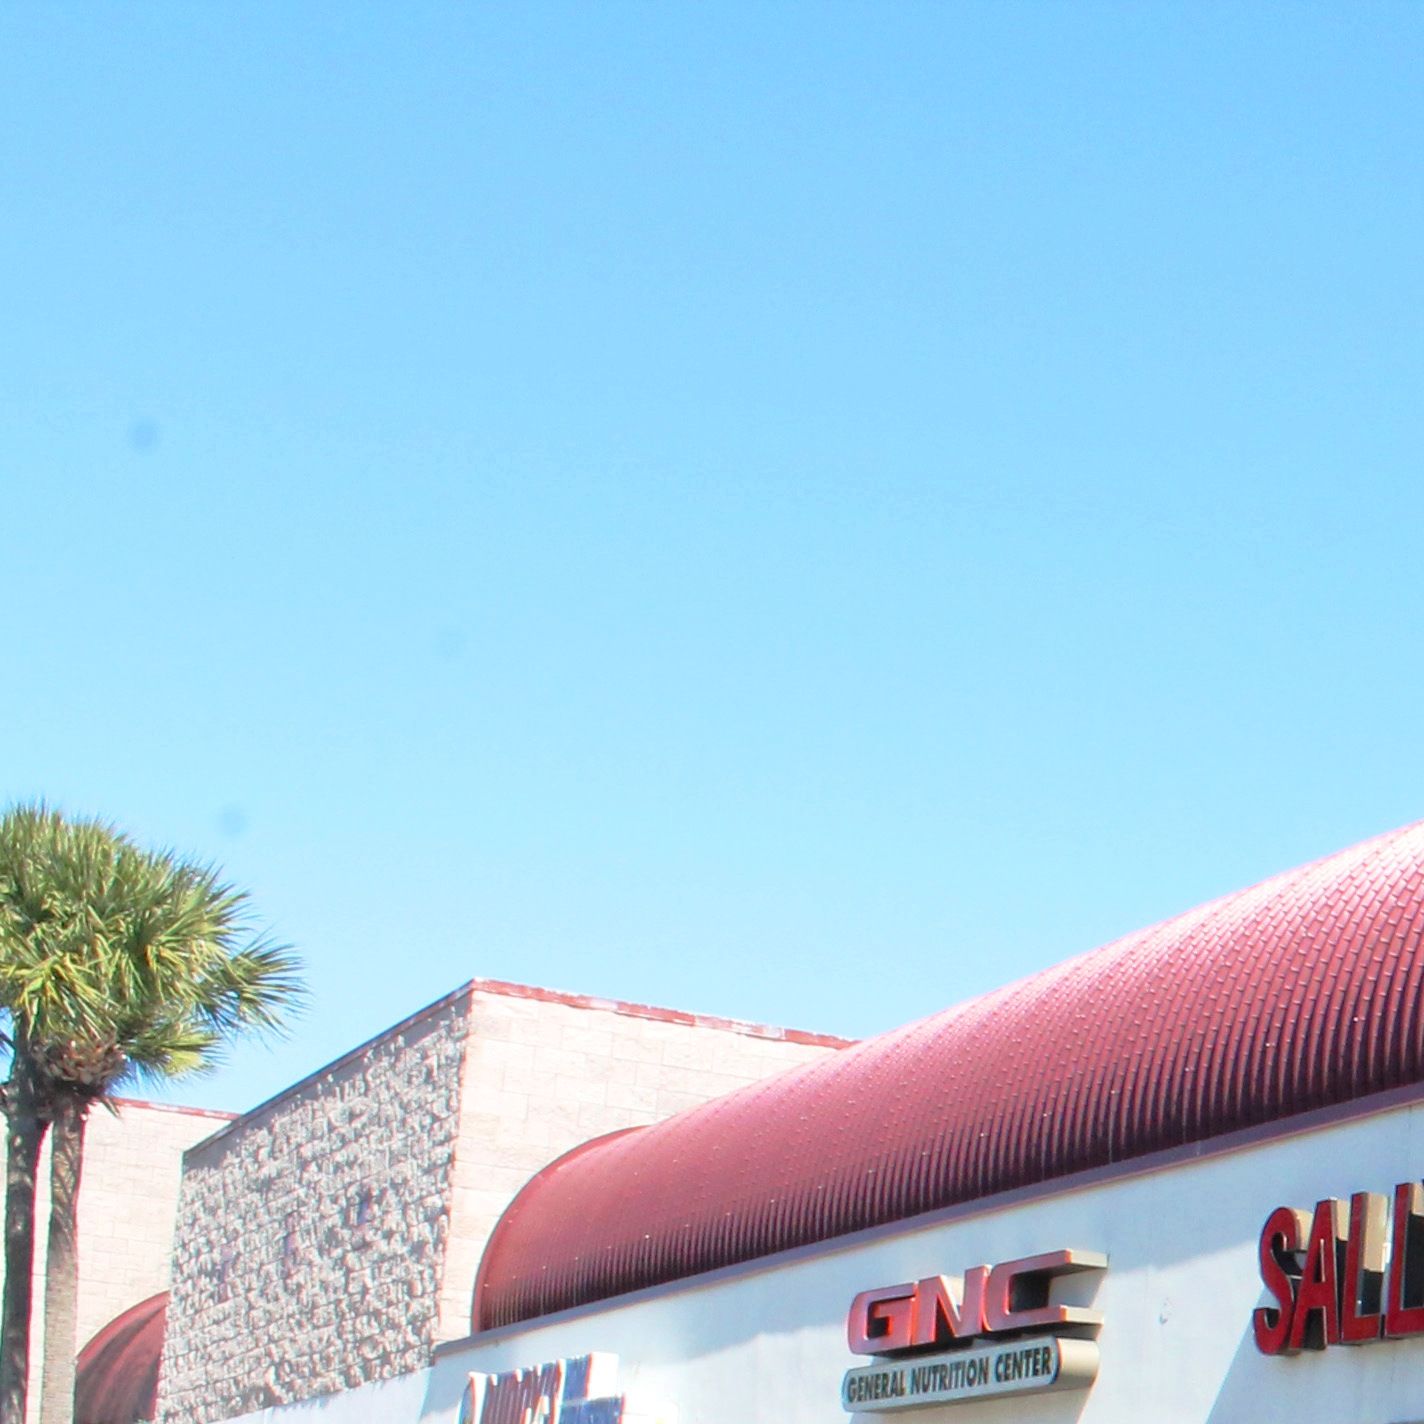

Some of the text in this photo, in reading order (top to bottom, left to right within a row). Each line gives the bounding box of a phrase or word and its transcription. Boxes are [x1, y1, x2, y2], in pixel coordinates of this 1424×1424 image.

[847, 1249, 1090, 1355] GNC
[849, 1346, 1052, 1403] GENERAL NUTRITION CENTER
